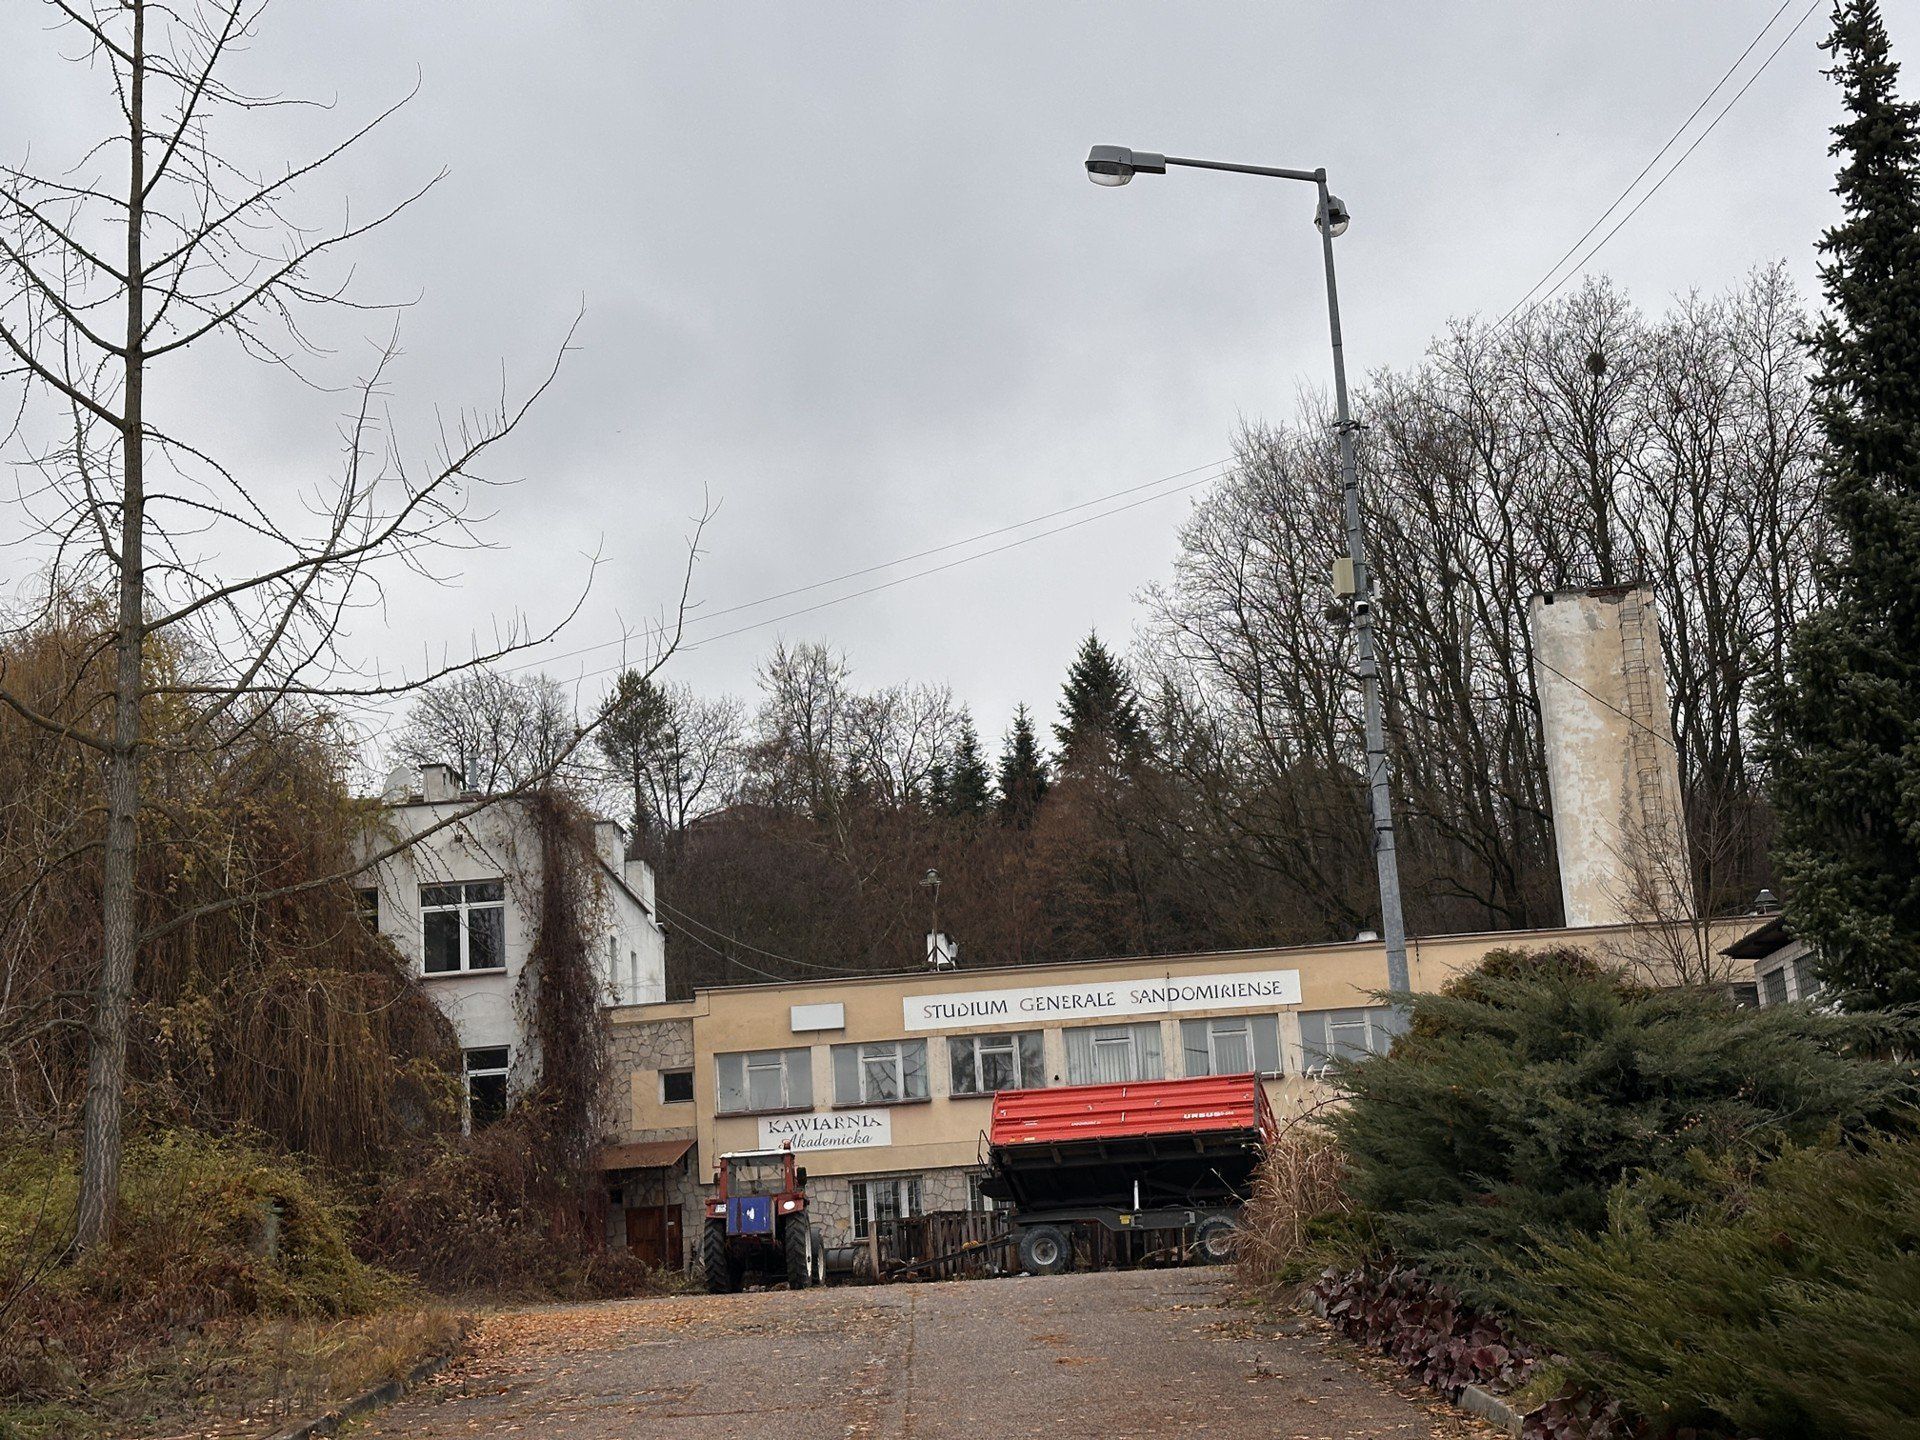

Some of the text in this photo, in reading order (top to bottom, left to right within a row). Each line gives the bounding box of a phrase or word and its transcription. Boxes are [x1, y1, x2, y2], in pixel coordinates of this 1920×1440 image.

[923, 981, 1282, 1018] STUDIUM GENERALE SANDOMIRIENSE
[768, 1115, 882, 1134] KAWIARNIA
